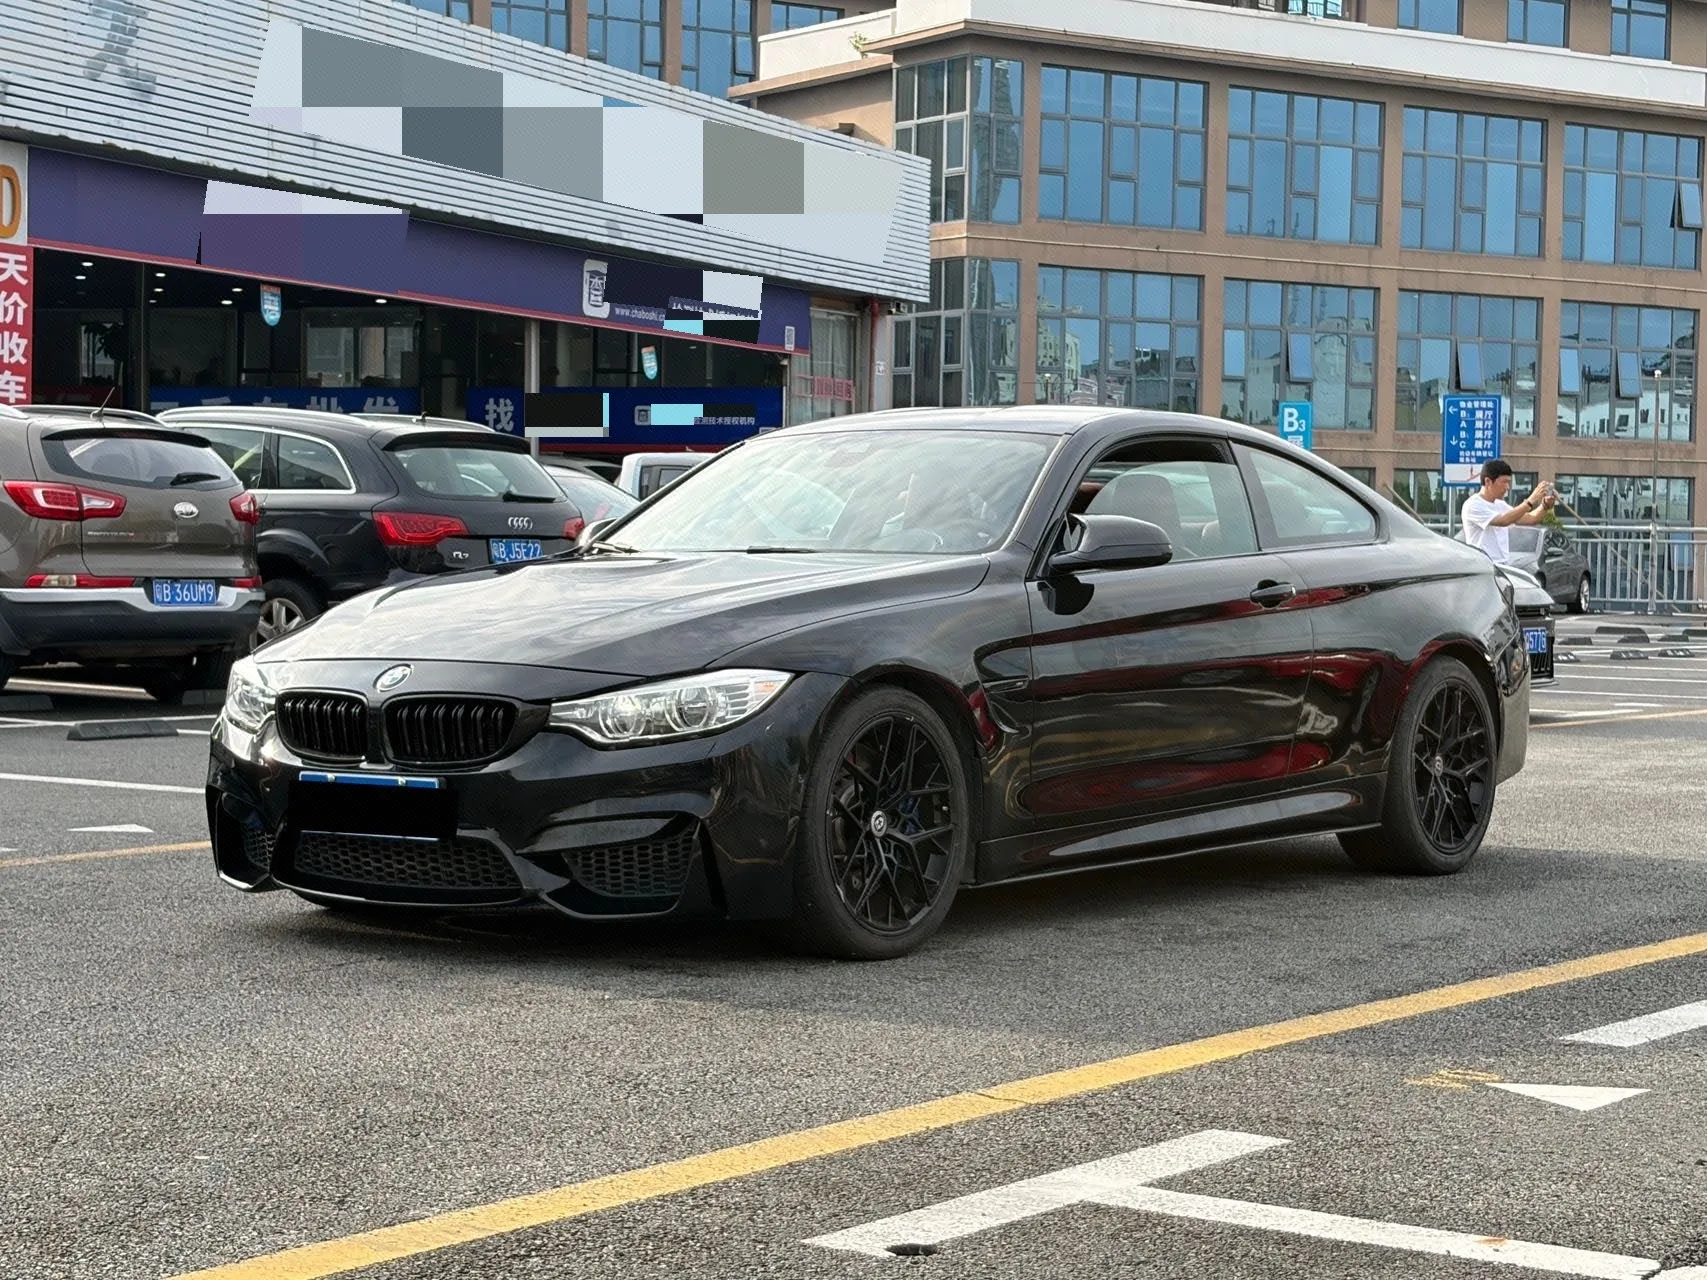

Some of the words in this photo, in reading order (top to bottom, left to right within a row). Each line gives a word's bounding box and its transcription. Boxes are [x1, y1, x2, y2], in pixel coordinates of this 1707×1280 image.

[0, 252, 28, 404] 天价收车
[485, 398, 514, 432] 找
[1283, 407, 1306, 433] B3
